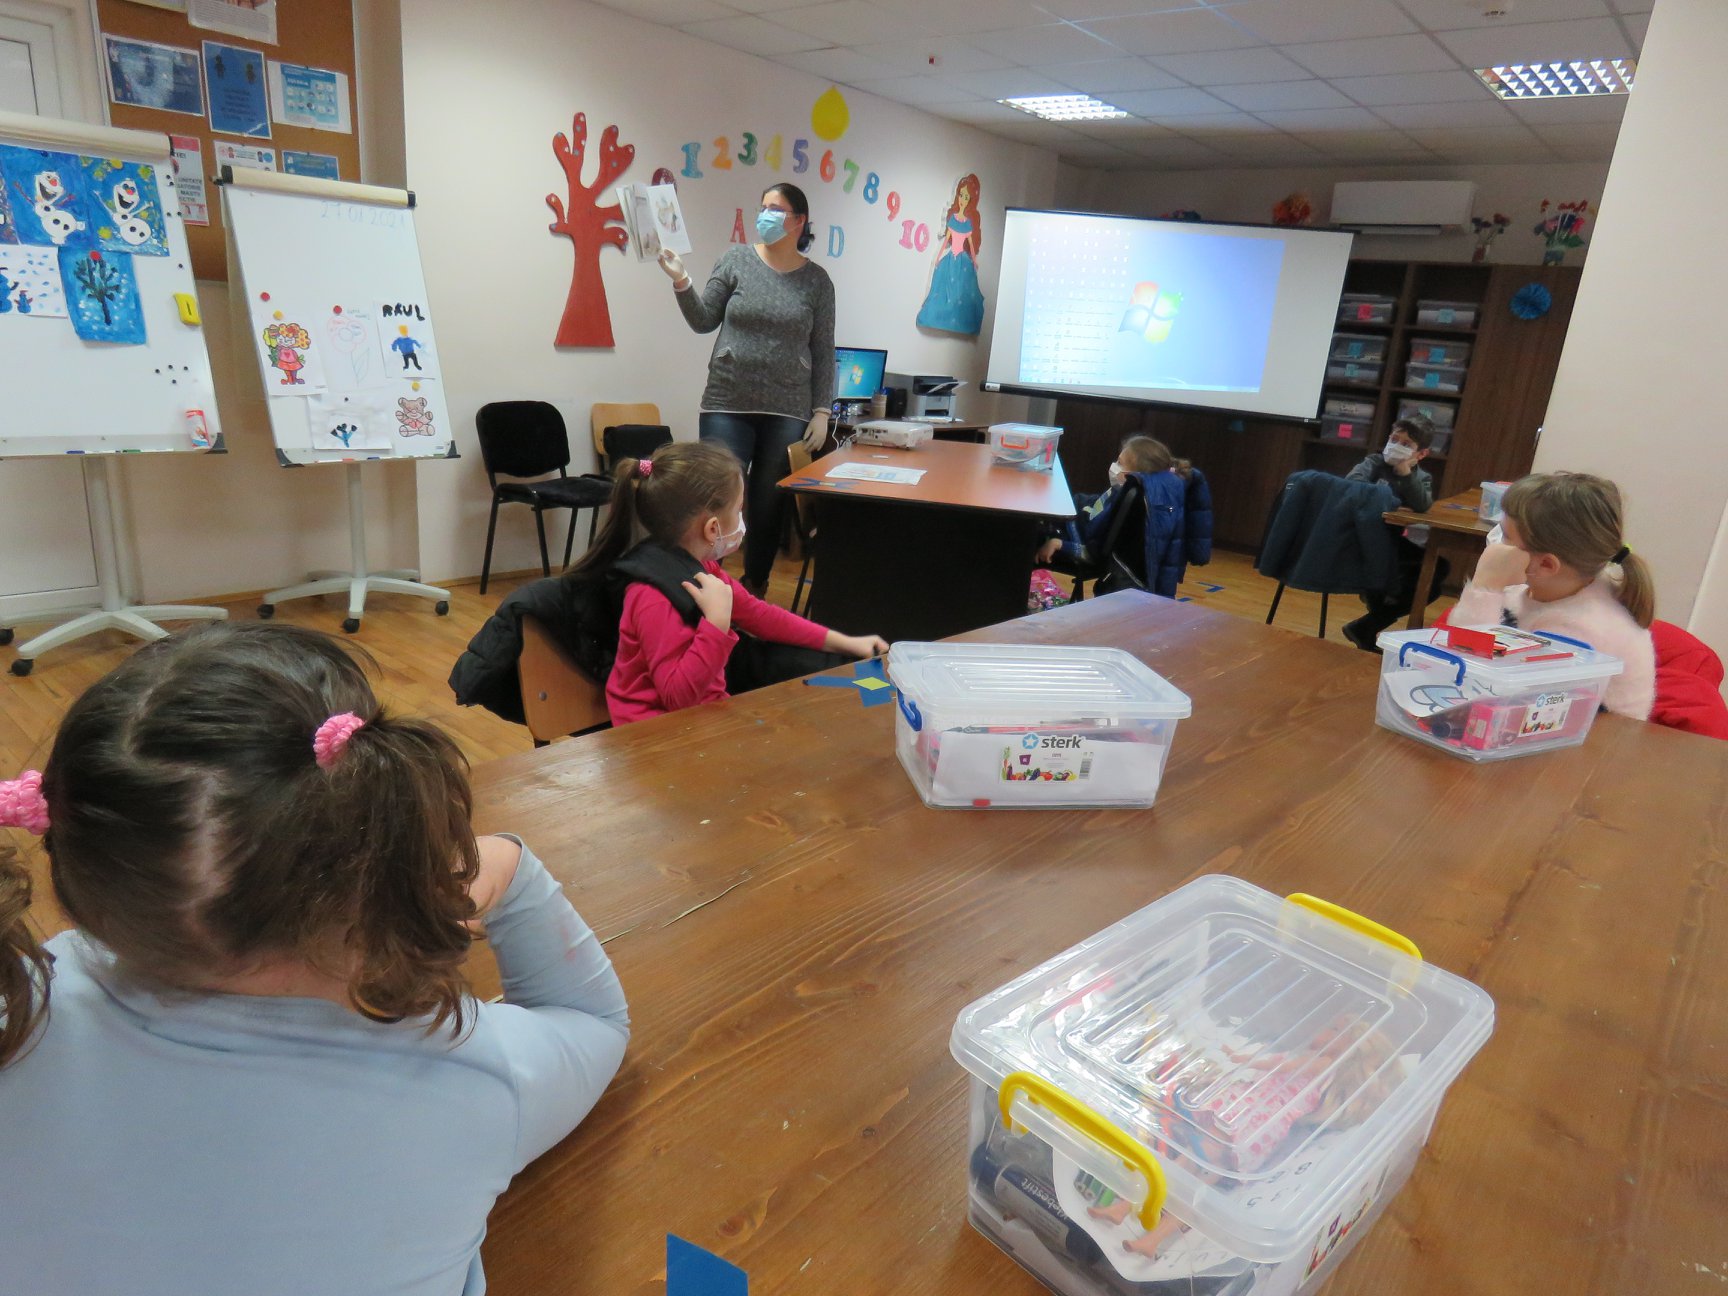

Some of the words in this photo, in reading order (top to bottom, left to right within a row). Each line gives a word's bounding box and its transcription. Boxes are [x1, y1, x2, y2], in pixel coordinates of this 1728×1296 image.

[681, 142, 703, 178] 1
[712, 137, 732, 170] 2
[738, 132, 758, 166] 3
[764, 134, 782, 171] 4
[793, 139, 809, 173] 5
[820, 149, 835, 183] 6
[843, 158, 860, 194] 7
[863, 172, 879, 204] 8
[887, 191, 901, 222] 9
[899, 219, 930, 252] 10
[730, 208, 746, 244] A
[827, 225, 845, 258] D
[382, 302, 425, 321] RAUL
[1546, 694, 1565, 706] sterk
[1041, 736, 1082, 749] sterk
